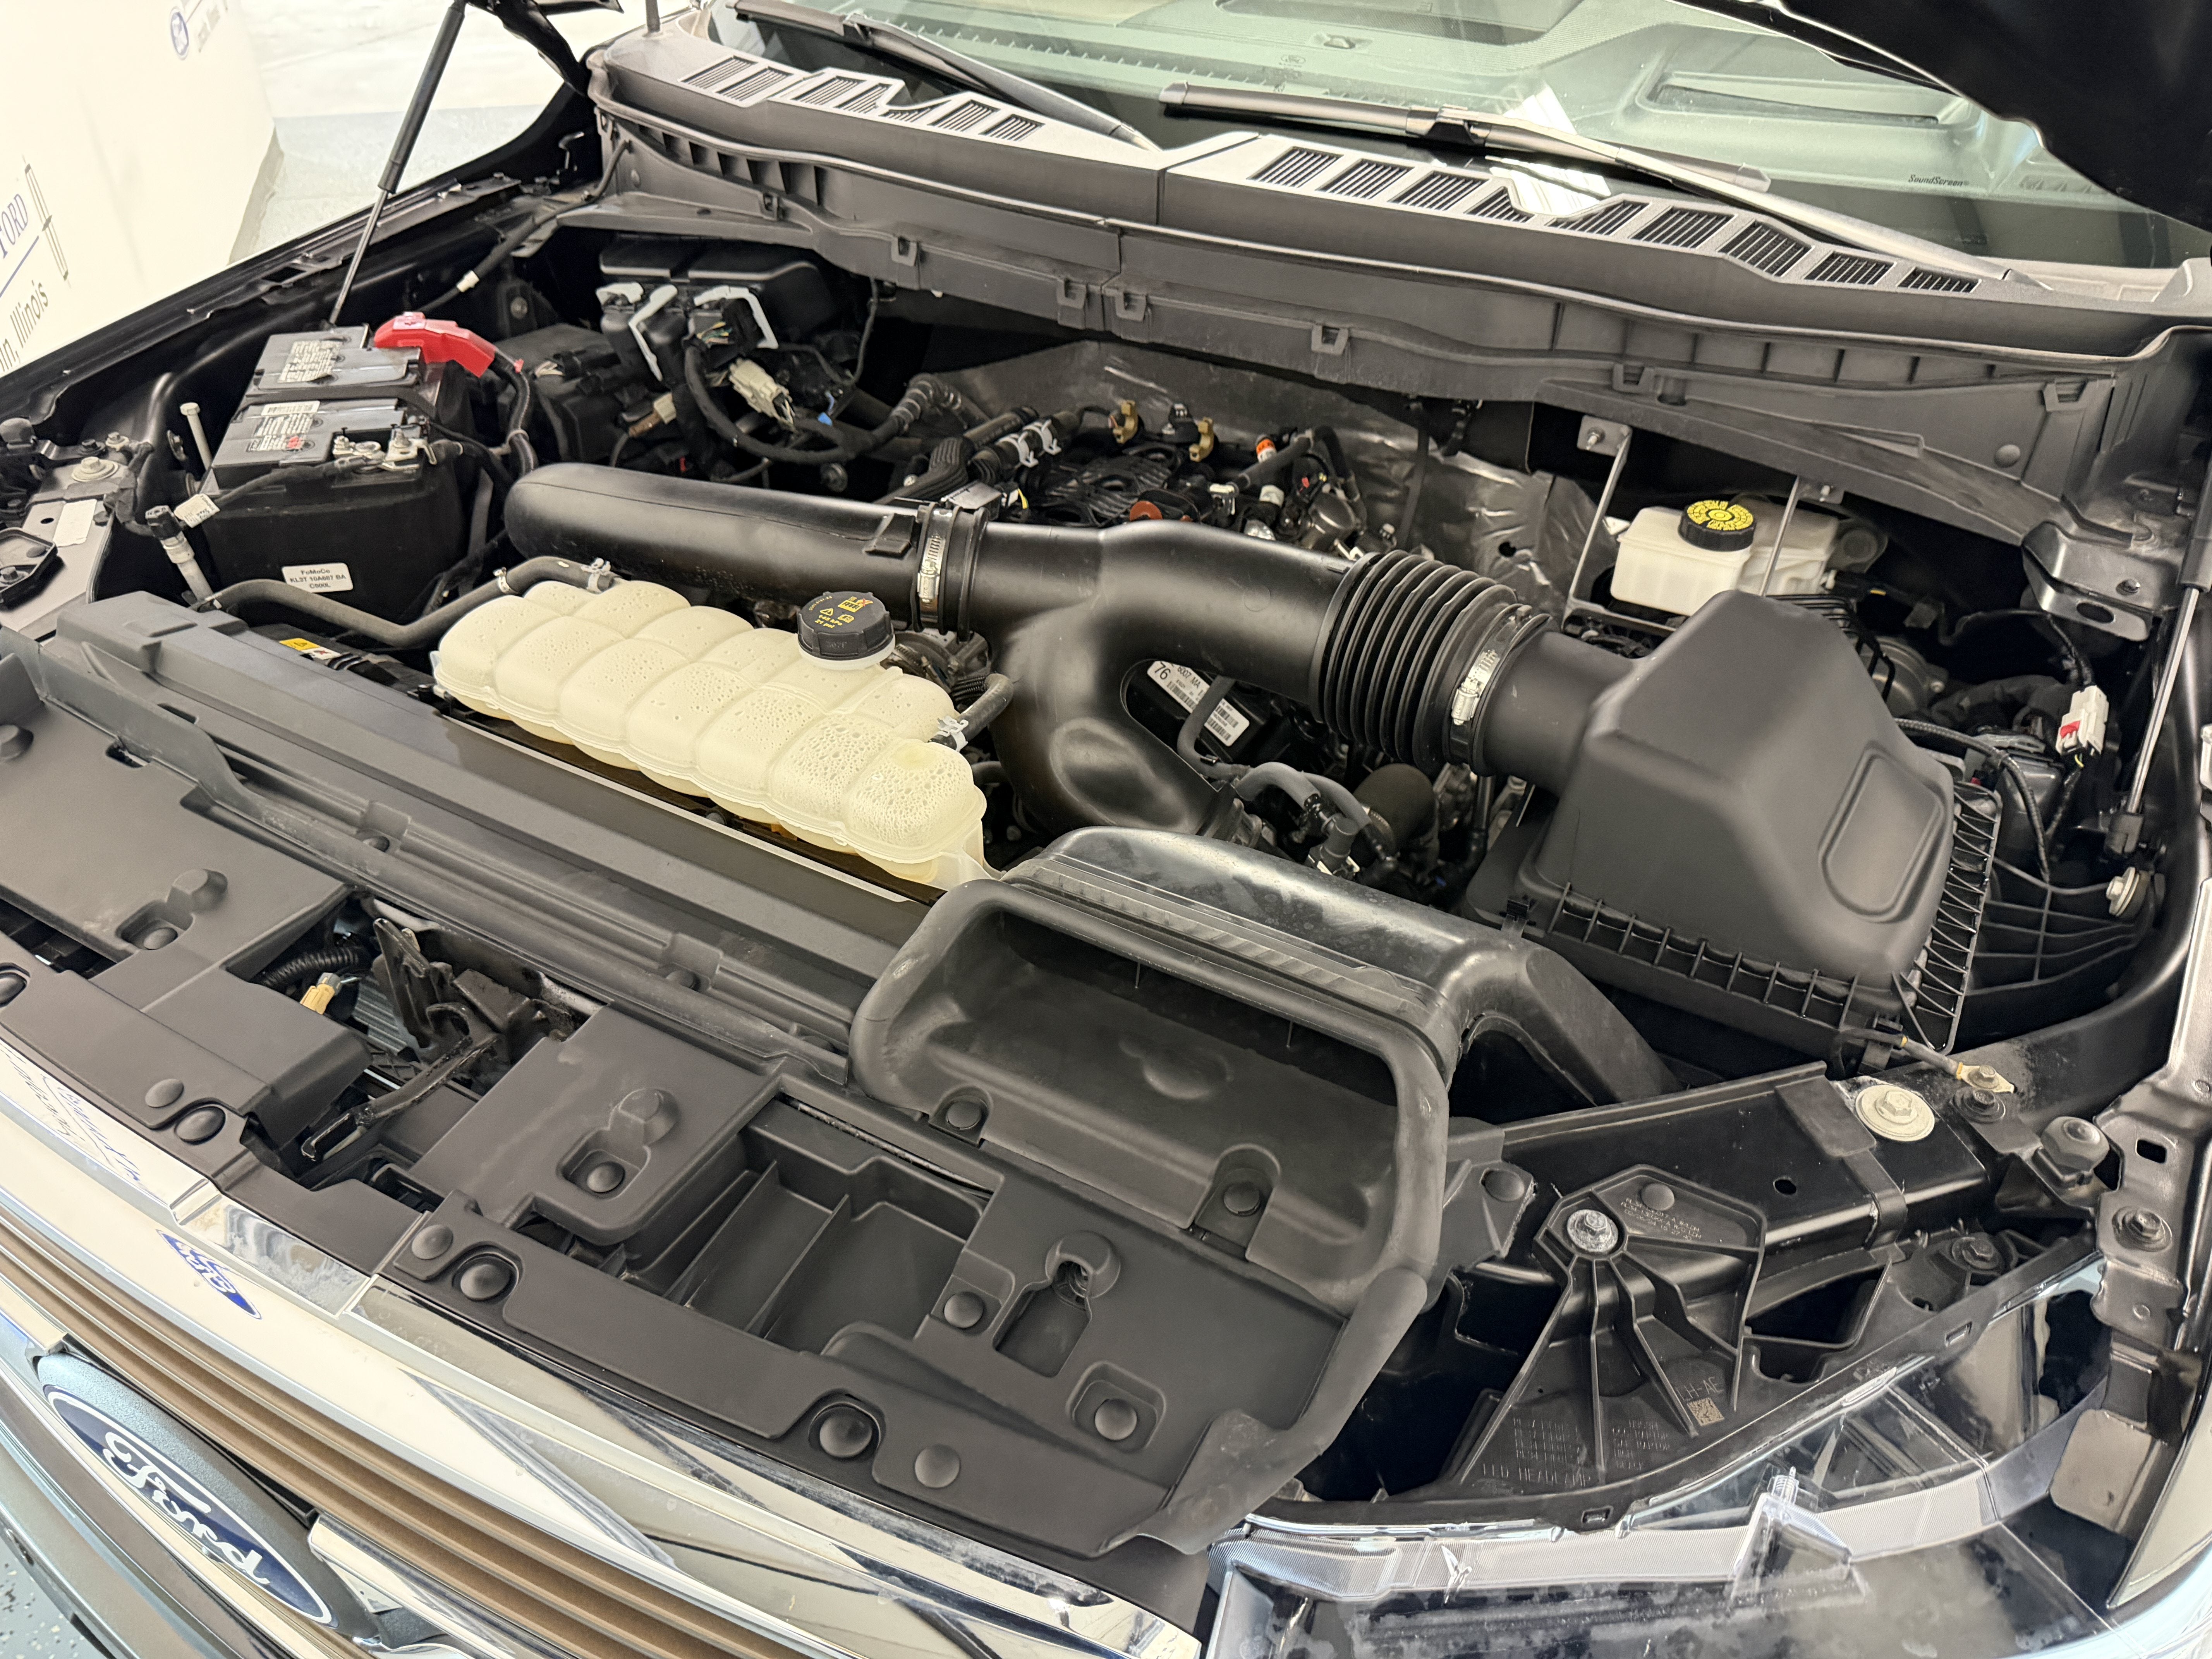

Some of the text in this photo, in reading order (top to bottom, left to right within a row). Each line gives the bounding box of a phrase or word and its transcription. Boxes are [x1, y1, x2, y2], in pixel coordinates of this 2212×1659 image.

[10, 280, 48, 349] Illinois
[1154, 661, 1171, 680] 76
[1676, 1376, 1724, 1401] LH-AE
[103, 1432, 271, 1585] Ford
